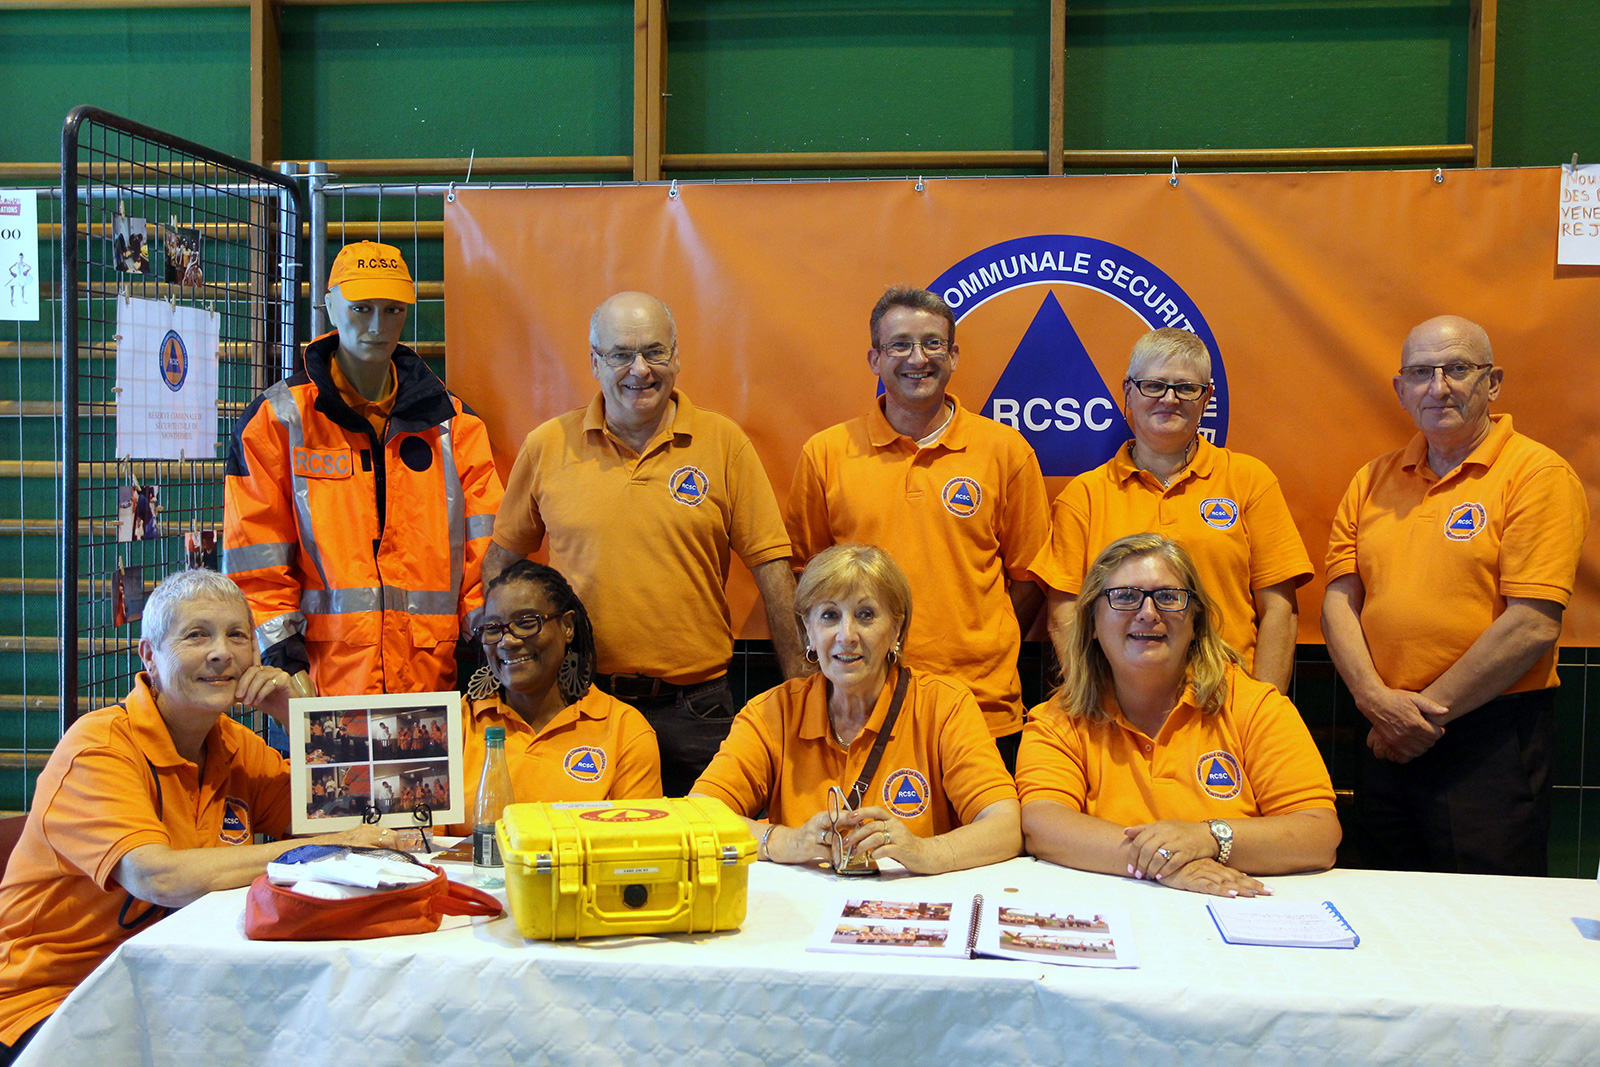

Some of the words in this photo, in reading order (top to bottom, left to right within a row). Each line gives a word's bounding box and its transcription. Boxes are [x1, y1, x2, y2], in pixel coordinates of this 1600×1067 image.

[1561, 188, 1590, 203] DES
[357, 258, 398, 269] R.C.S.C
[943, 250, 1092, 309] OMMUNALE
[1097, 259, 1198, 337] SECURIT
[993, 397, 1113, 432] RCSC
[296, 451, 349, 474] RCSC
[954, 493, 971, 501] RCSC
[577, 761, 595, 769] RCSC
[1209, 772, 1229, 780] RCSC
[898, 790, 917, 798] RCSC
